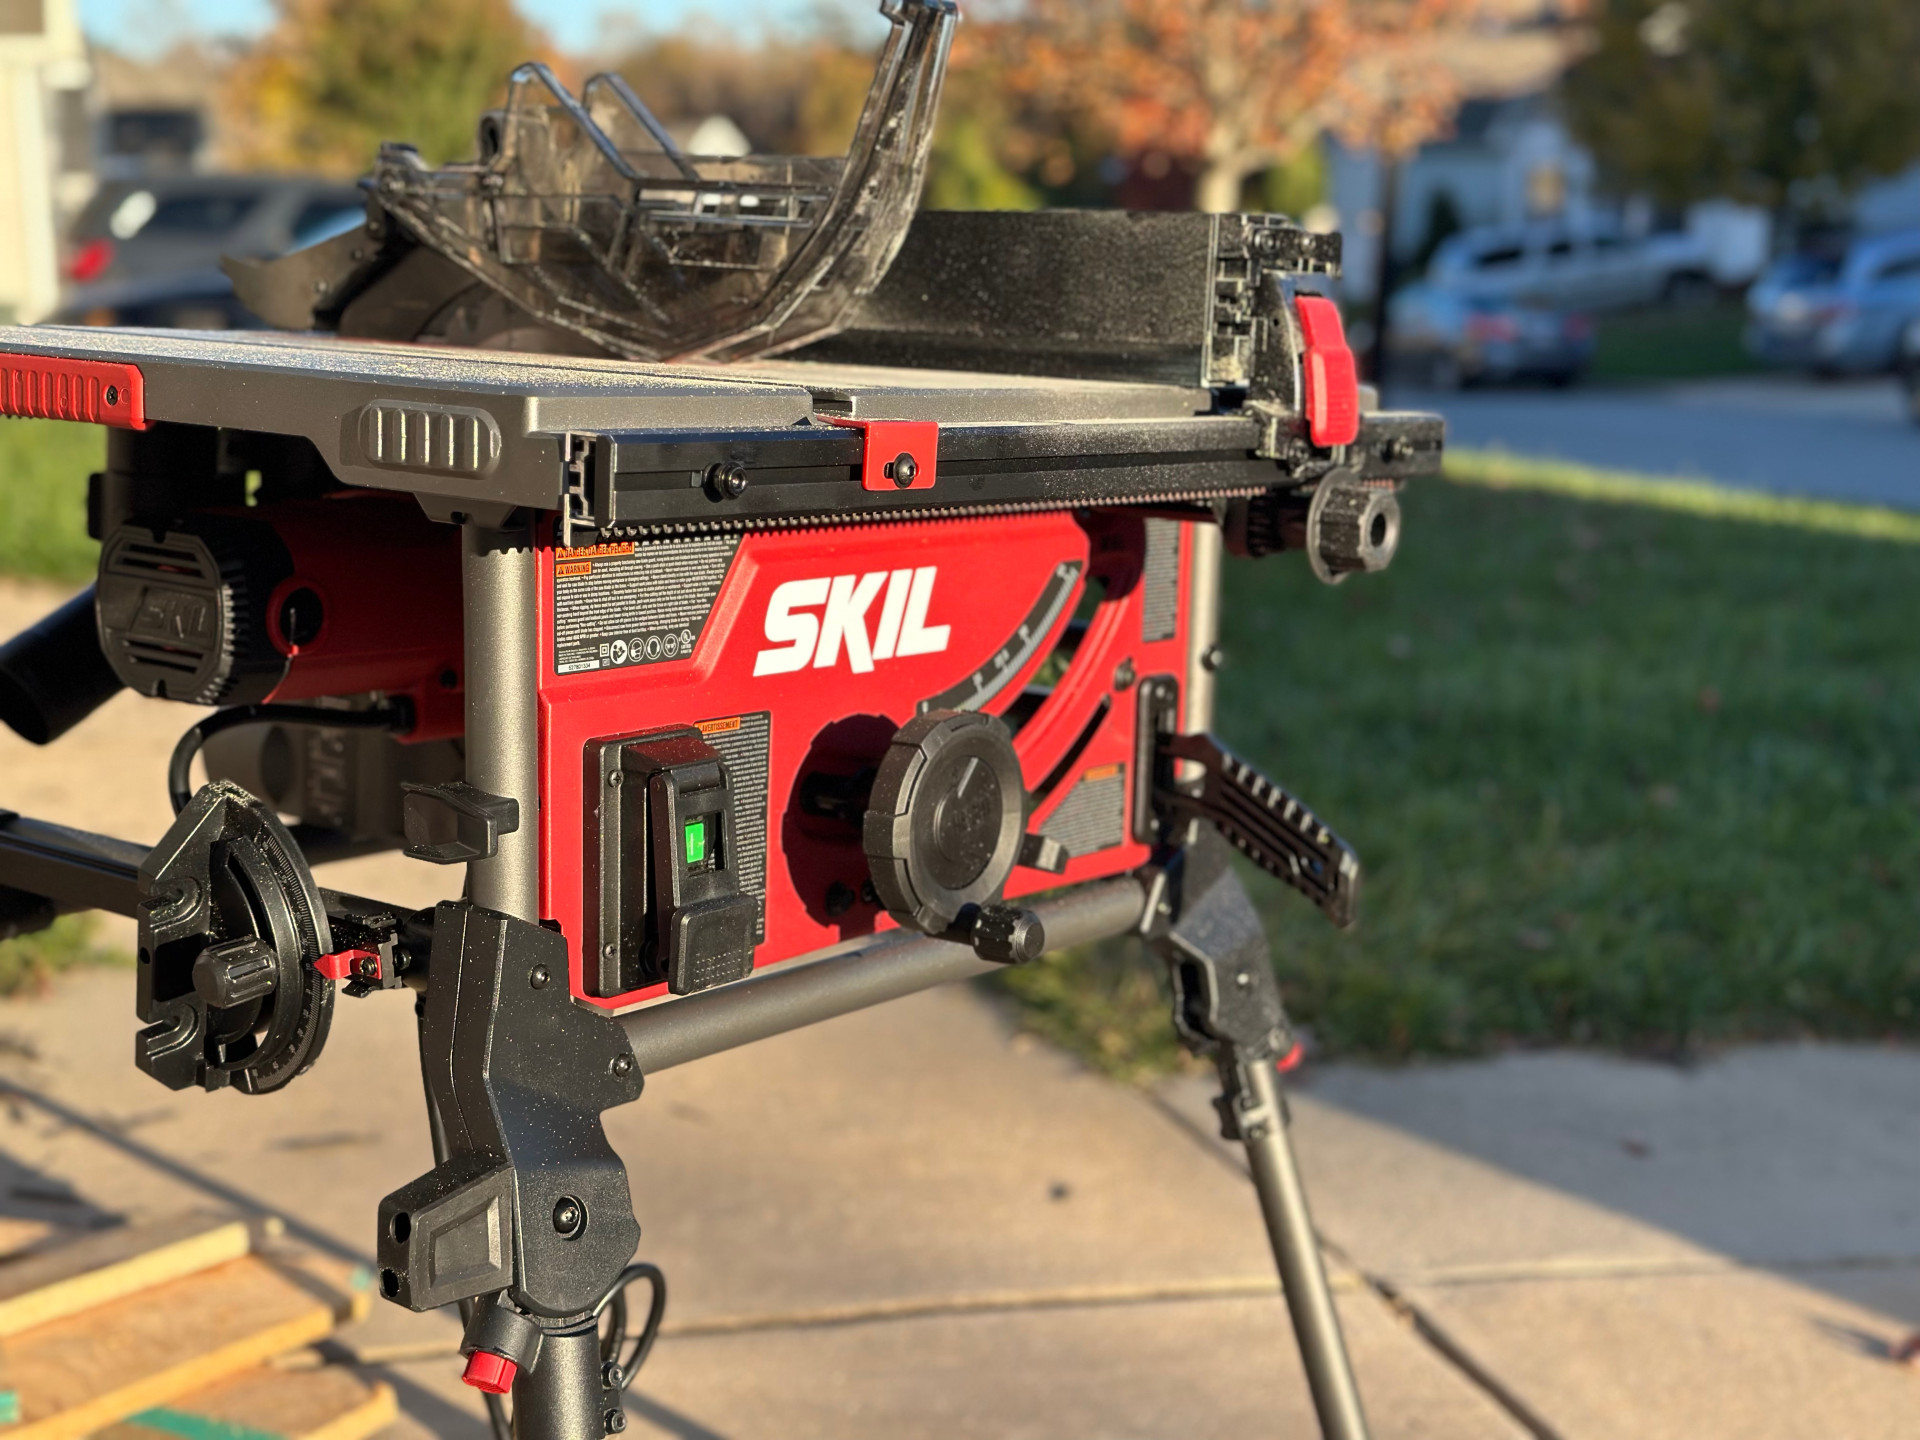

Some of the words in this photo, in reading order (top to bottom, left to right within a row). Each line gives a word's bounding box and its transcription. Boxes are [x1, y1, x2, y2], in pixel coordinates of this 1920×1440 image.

[565, 564, 590, 574] WARNING
[753, 566, 951, 677] SKIL
[702, 720, 738, 732] AVERTISSEMENT
